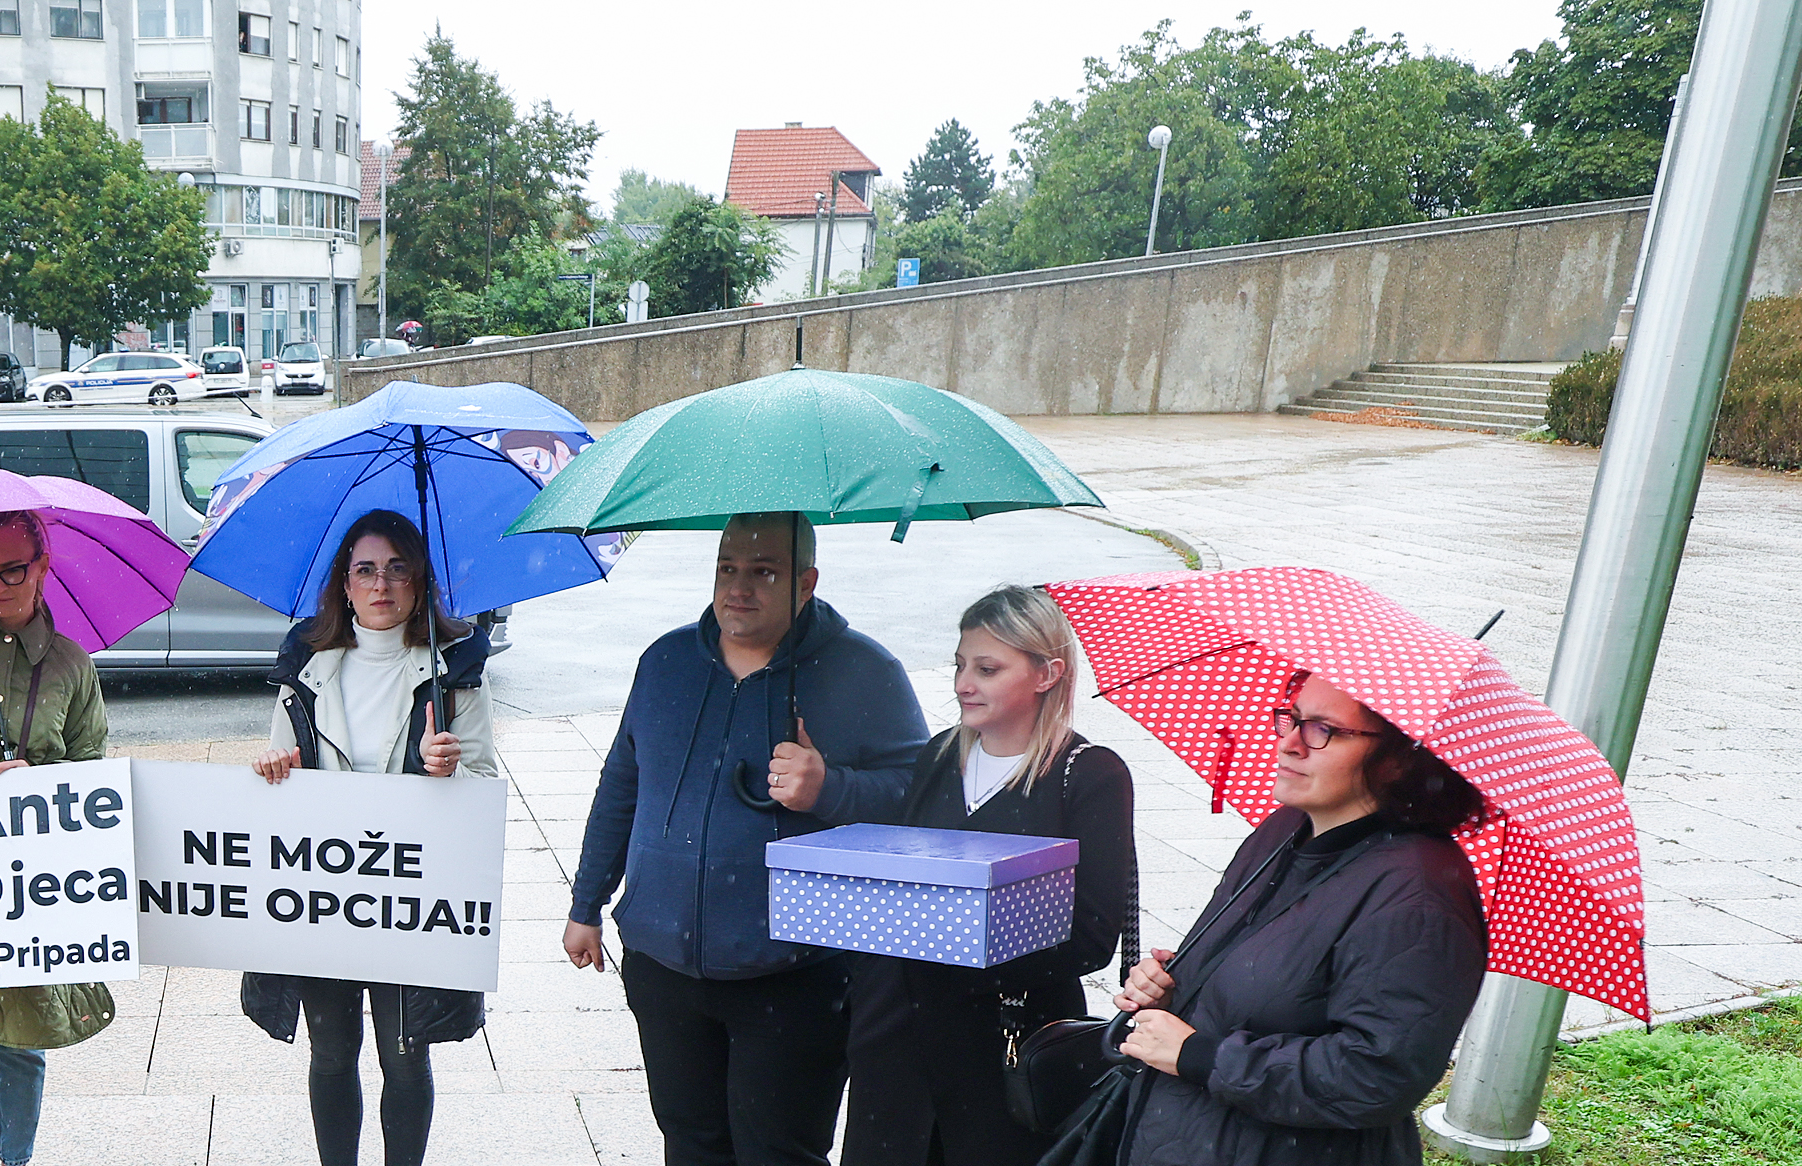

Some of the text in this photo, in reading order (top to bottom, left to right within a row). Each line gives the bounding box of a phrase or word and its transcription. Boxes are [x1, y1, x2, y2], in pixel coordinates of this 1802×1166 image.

[183, 829, 423, 879] NE MOŽE
[138, 880, 492, 937] NIJE OPCIJA!!
